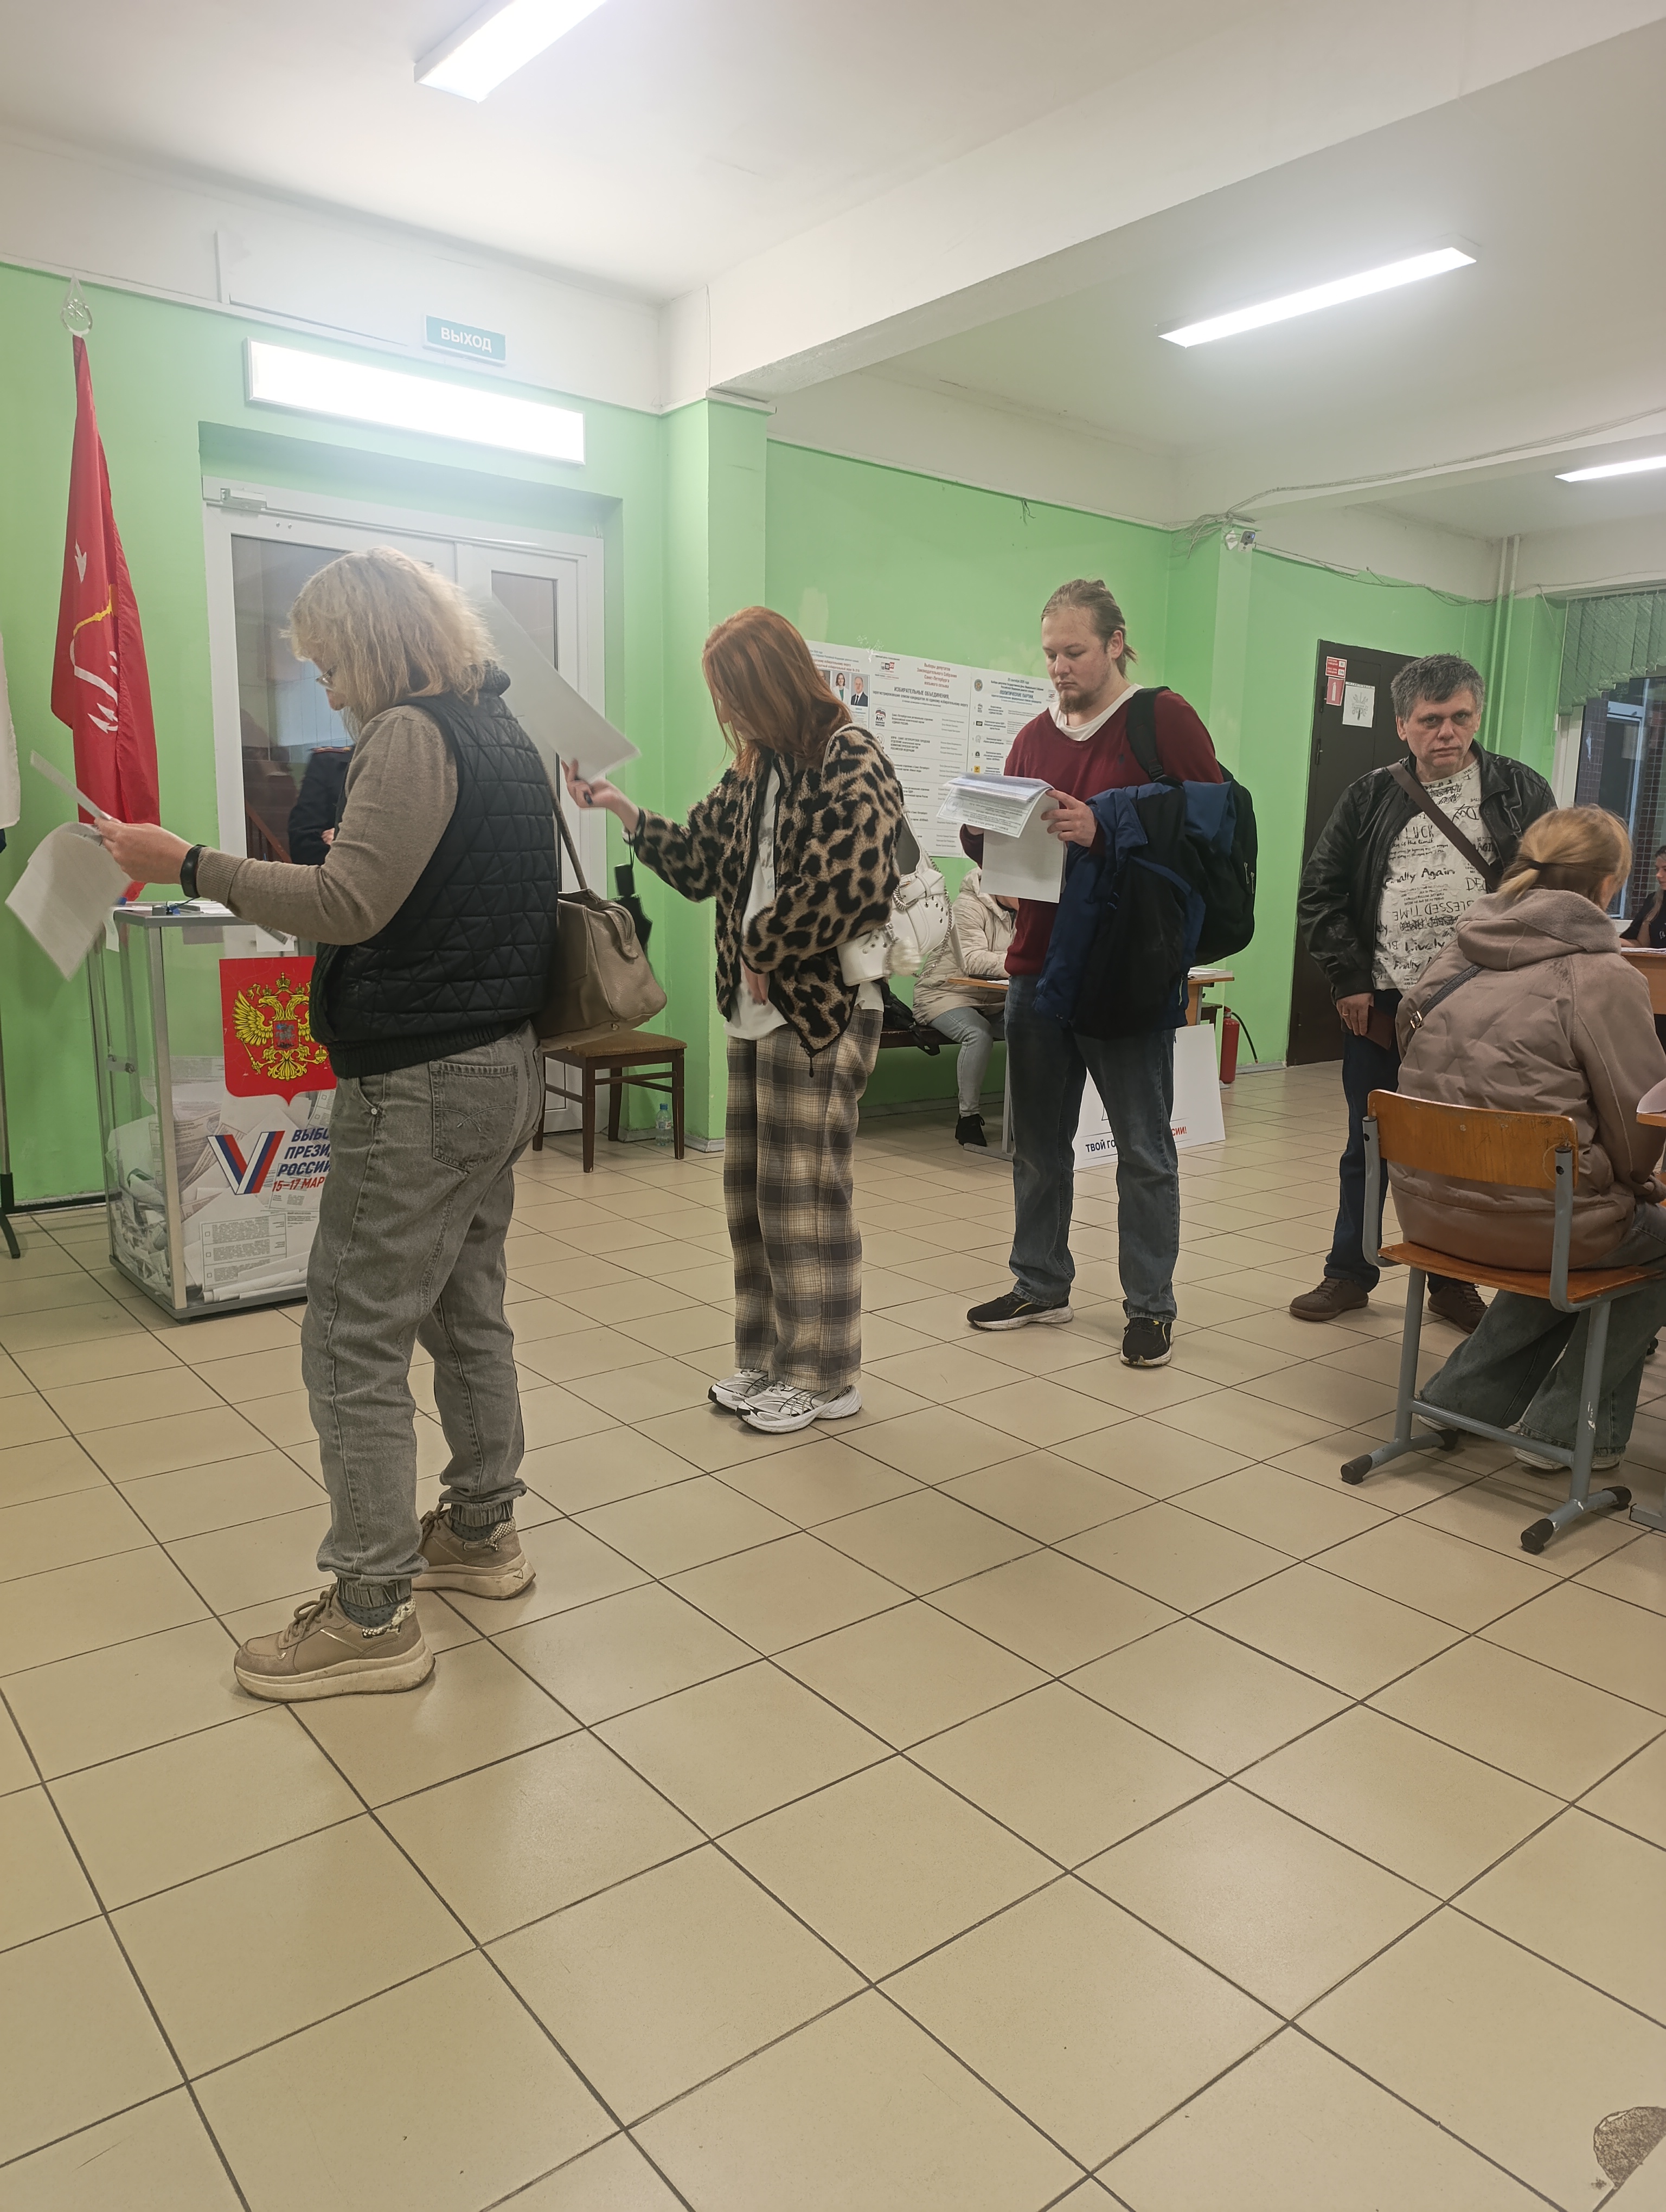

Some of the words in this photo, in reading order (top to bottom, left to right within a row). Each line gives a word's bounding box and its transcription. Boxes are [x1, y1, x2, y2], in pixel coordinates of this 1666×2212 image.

[441, 327, 492, 353] ВЫХОД
[894, 686, 924, 696] ИЗБИРАТЕЛЬНЫЕ
[925, 691, 949, 699] ОБЪЕДИНЕНИЯ,
[1406, 825, 1434, 839] LUCK
[1385, 872, 1417, 889] Finally
[1421, 867, 1456, 880] Again
[1392, 905, 1422, 921] TIME
[1406, 938, 1445, 951] Lively
[1171, 1127, 1187, 1137] СИИ!
[284, 1144, 330, 1159] ПРЕЗИ
[1086, 1139, 1105, 1153] ТВОЙ
[1107, 1139, 1116, 1149] ГО
[301, 1176, 325, 1189] МАР
